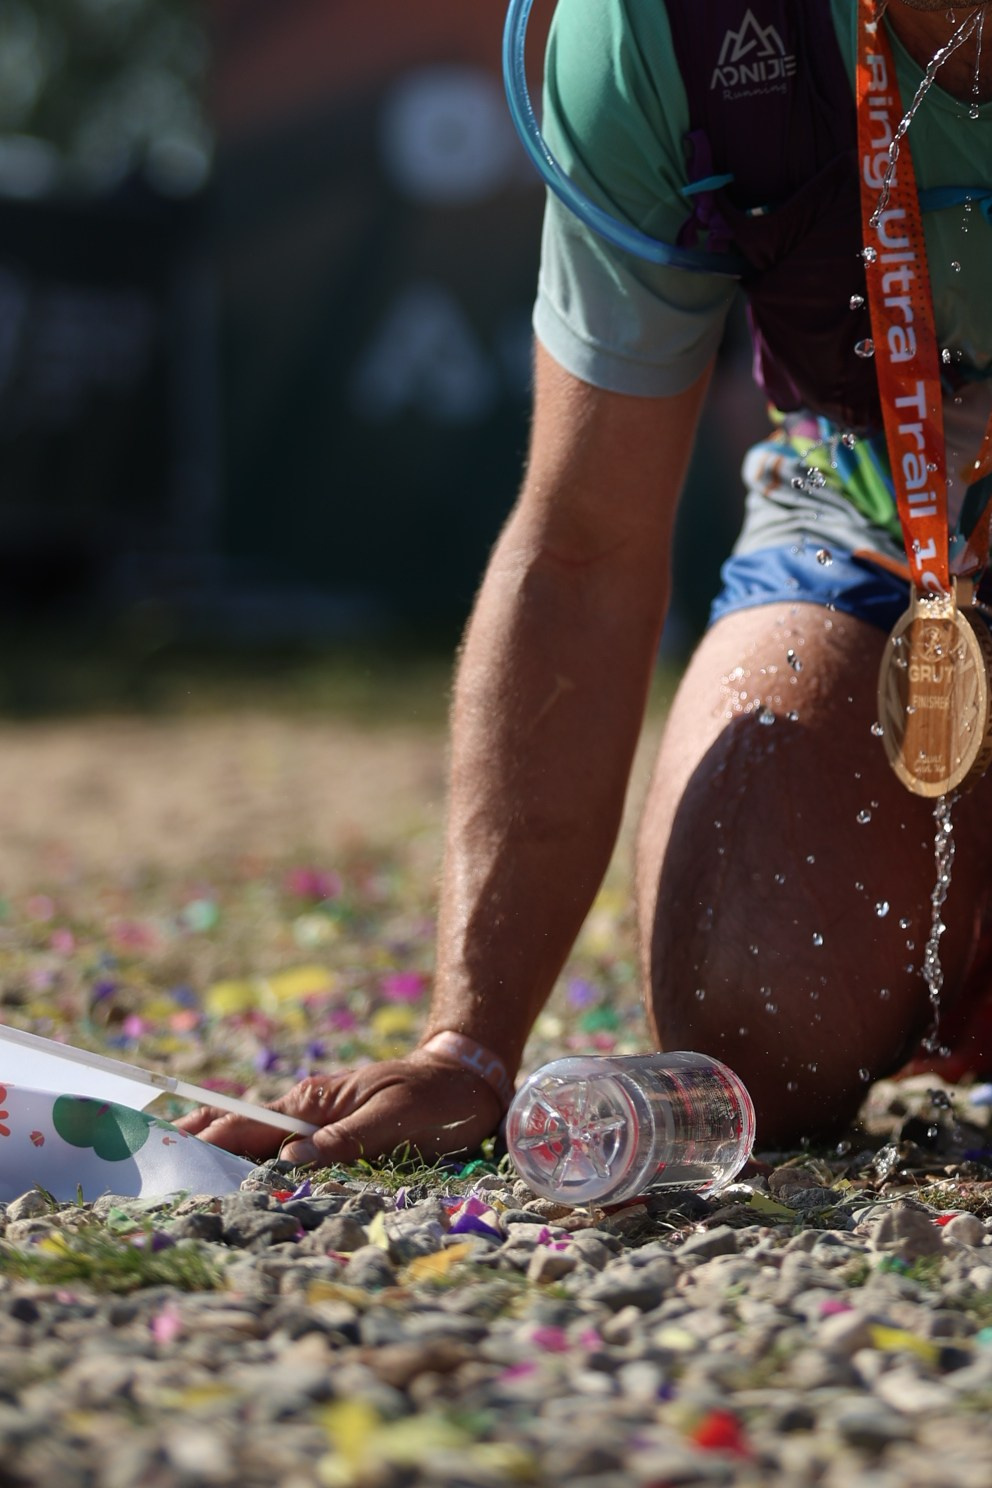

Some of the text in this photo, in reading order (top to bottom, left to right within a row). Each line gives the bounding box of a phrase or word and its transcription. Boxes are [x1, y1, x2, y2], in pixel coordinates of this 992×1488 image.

[863, 54, 899, 190] Ring
[877, 209, 918, 363] Ultra
[895, 380, 938, 519] Trail
[908, 664, 954, 683] GRUT
